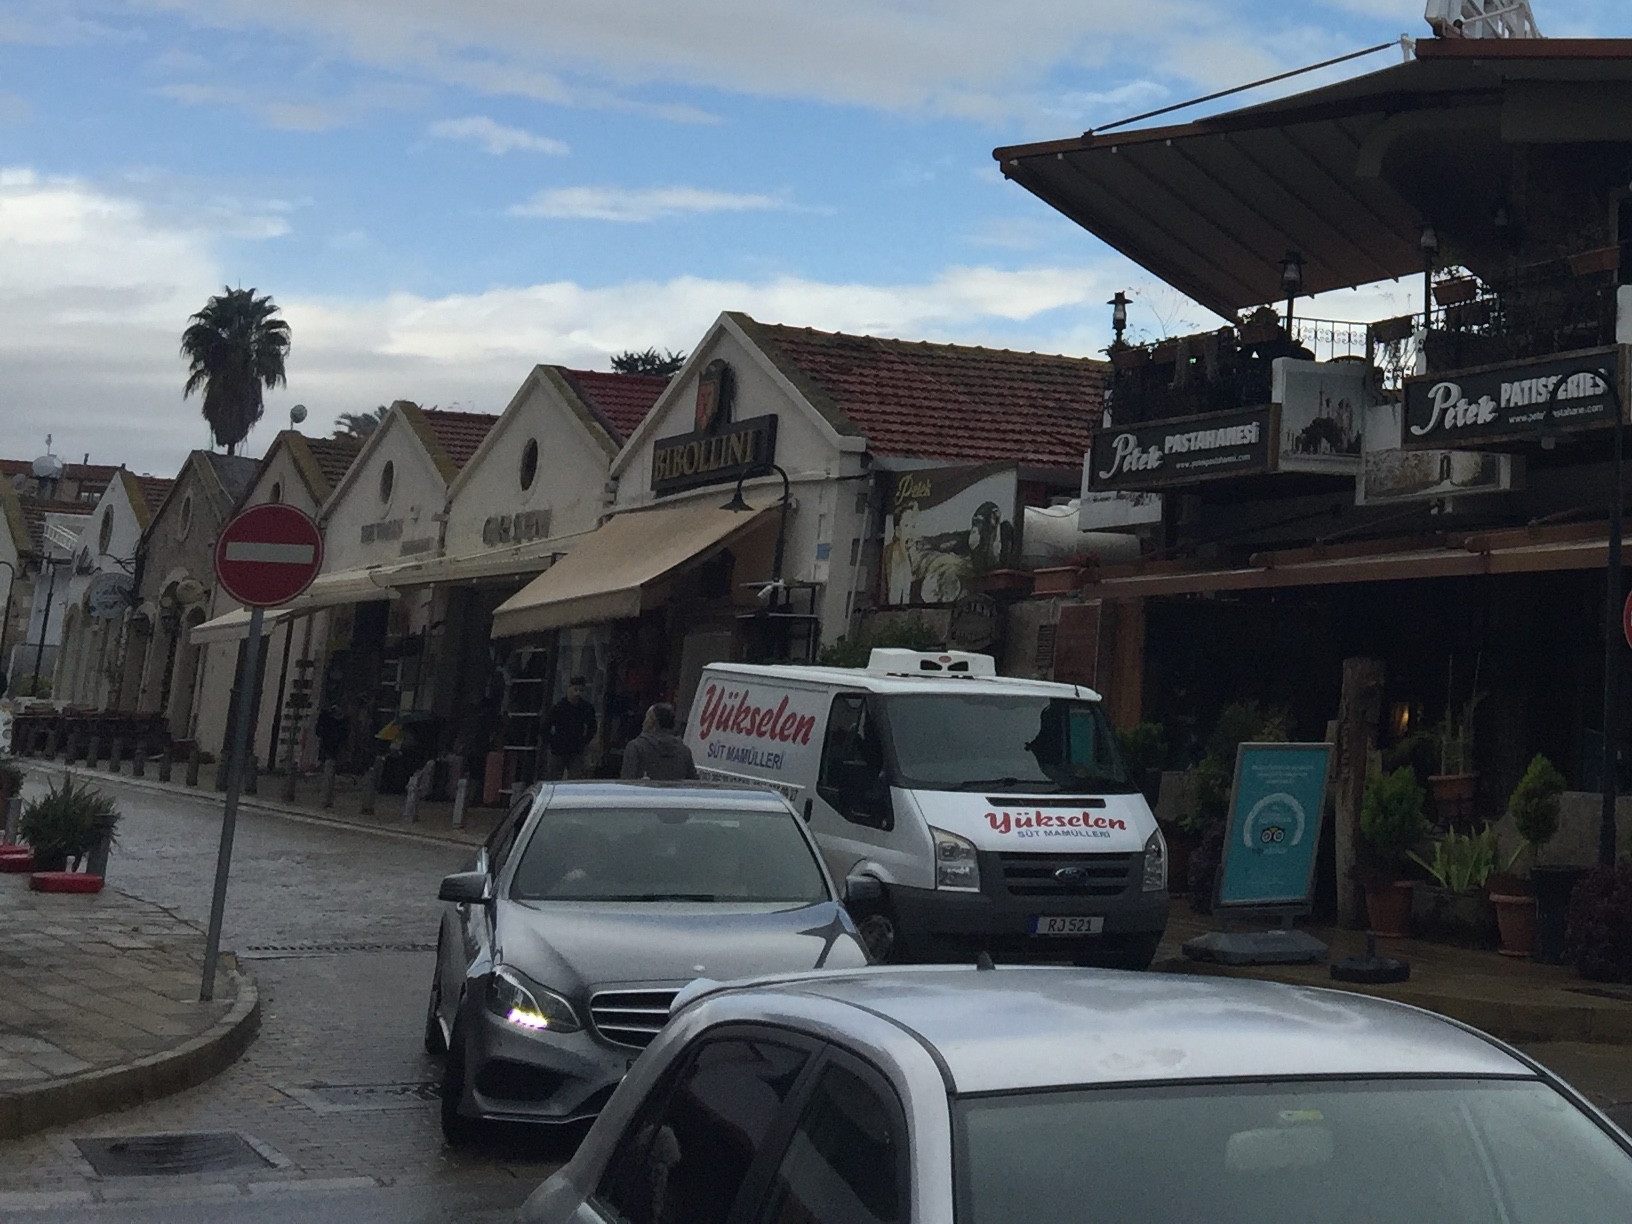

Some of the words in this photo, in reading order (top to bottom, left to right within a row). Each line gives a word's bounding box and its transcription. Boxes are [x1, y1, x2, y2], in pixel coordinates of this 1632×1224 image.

[1410, 382, 1498, 435] Petek
[1099, 434, 1163, 479] Petek
[699, 683, 816, 746] Yükselen
[984, 810, 1127, 834] Yükselen
[1017, 829, 1041, 838] SÜT
[1047, 918, 1067, 932] RJ
[1068, 918, 1092, 932] 521
